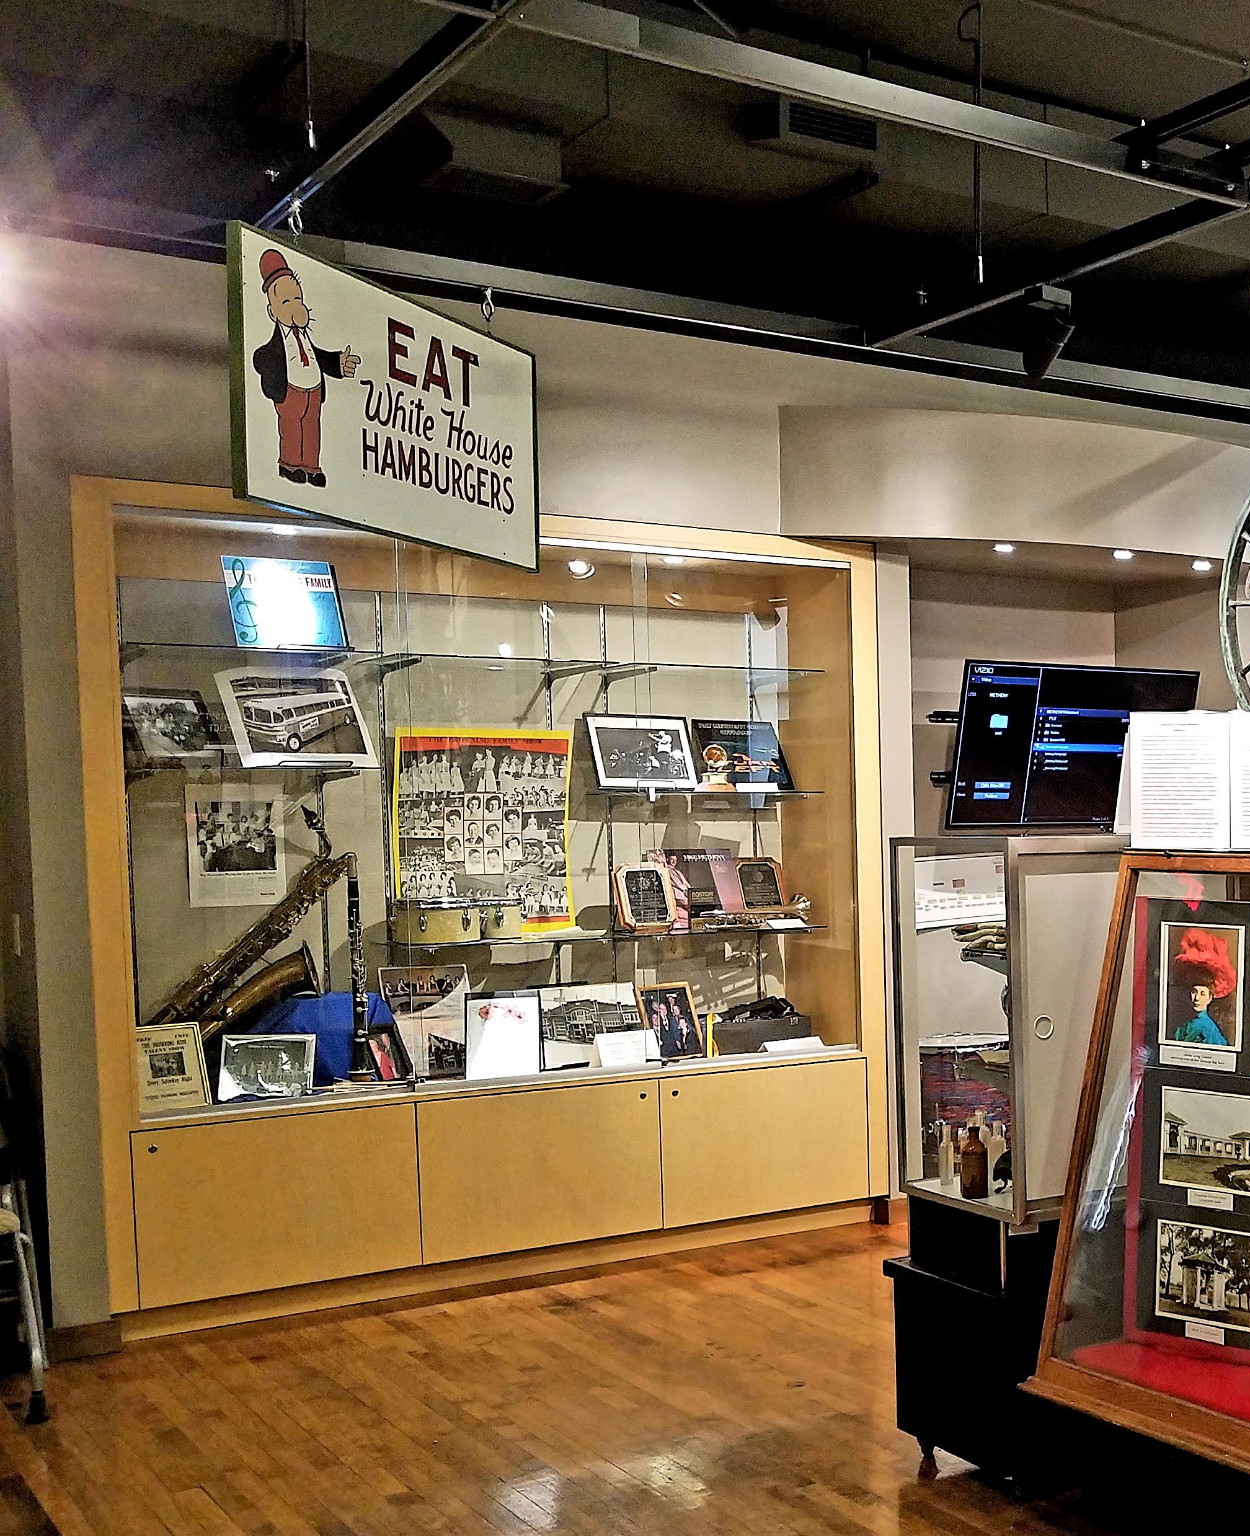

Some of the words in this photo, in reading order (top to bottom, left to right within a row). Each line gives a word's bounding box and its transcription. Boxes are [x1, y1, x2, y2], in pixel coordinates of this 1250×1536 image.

[388, 317, 479, 408] EAT
[360, 380, 435, 441] White
[441, 408, 513, 469] House
[362, 427, 515, 515] HAMBURGERS
